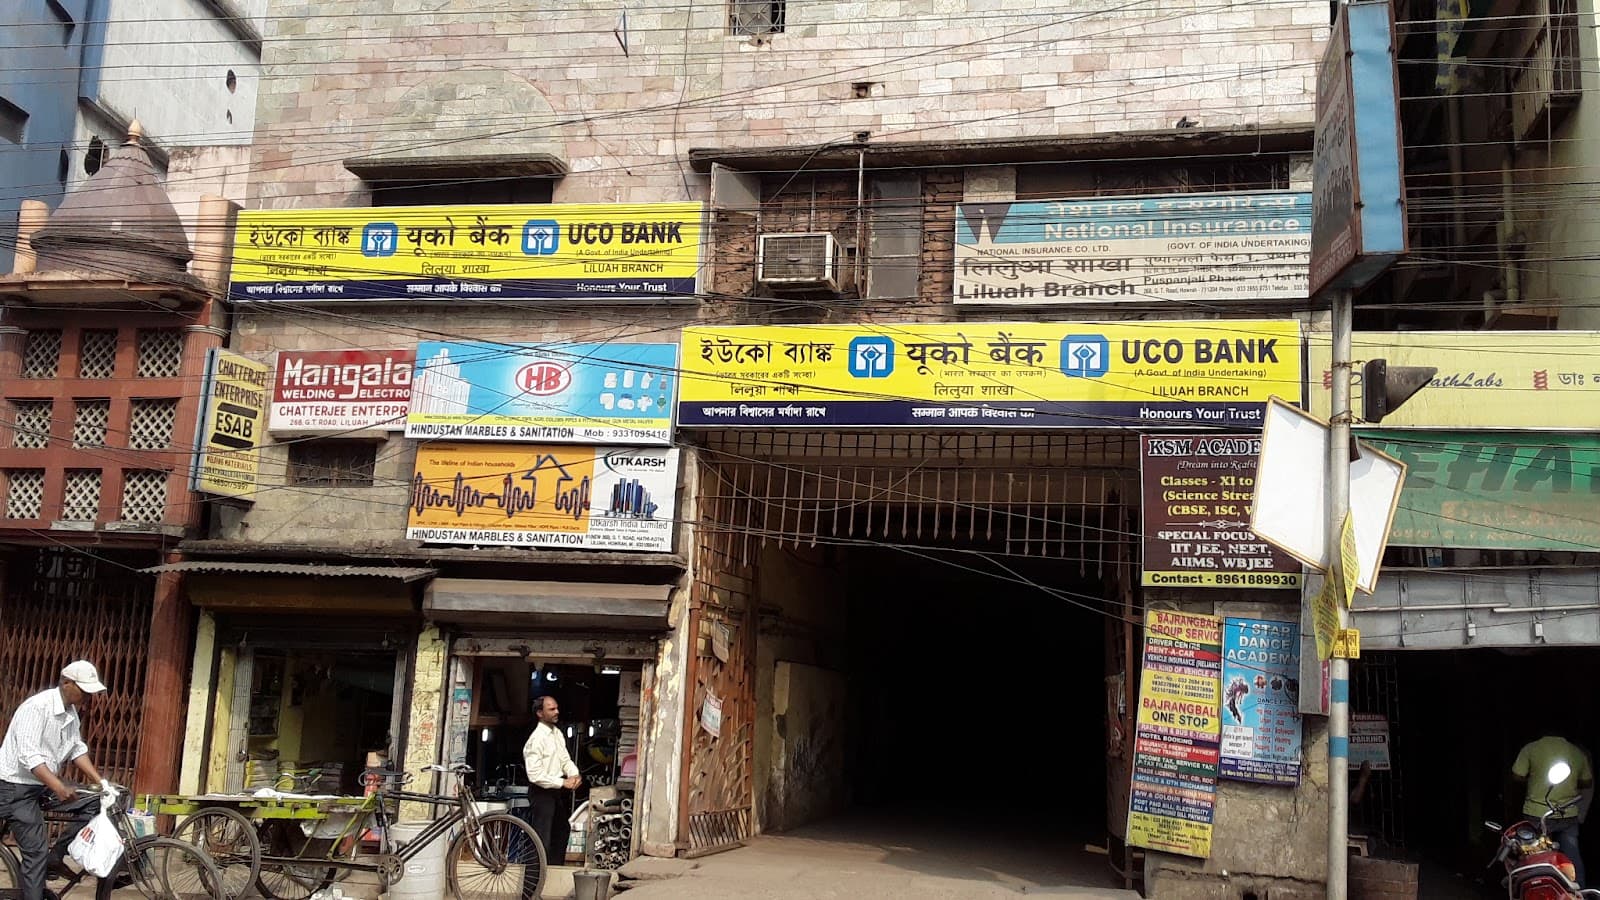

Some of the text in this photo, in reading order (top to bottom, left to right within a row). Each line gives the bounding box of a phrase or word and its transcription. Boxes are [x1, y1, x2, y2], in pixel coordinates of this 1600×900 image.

[250, 222, 352, 248] ইউকো ব্যাঙ্ক
[568, 222, 683, 245] UCO BANK
[1044, 218, 1300, 240] National Insurance
[406, 216, 513, 257] यूको बैंक
[1241, 238, 1311, 248] UNDERTAKING)
[612, 248, 628, 256] India
[977, 248, 1020, 256] NATIONAL
[1022, 246, 1072, 255] INSURANCE
[462, 264, 490, 274] शाखा
[584, 264, 664, 273] LILUAH BRANCH
[1064, 257, 1133, 273] शाखा
[576, 282, 667, 292] Honours Your Trust
[958, 282, 1034, 300] Liluah
[1044, 280, 1135, 298] Branch
[700, 336, 836, 365] ইউকো ব্যাঙ্ক
[904, 332, 1048, 376] यूको बैंक
[1122, 338, 1279, 364] UCO BANK
[218, 358, 266, 386] CHATTERJEE
[1208, 369, 1266, 378] Undertaking)
[524, 366, 562, 392] HB
[1430, 371, 1503, 388] athLabs
[214, 381, 264, 408] ENTERPRISE
[282, 389, 410, 398] WELDING ELECTRO
[731, 382, 766, 397] লিলুয়া
[934, 382, 1014, 398] लिलुया शाखा
[1152, 386, 1249, 396] LILUAH BRANCH
[280, 406, 408, 416] CHATTERJEE ENTERPR
[702, 406, 736, 417] আপনার
[740, 404, 775, 418] বিশ্বাসের
[806, 406, 826, 417] রাখে
[912, 408, 946, 418] सम्मान
[1140, 408, 1261, 419] Honours Your Trust
[215, 412, 253, 438] ESAB
[410, 424, 667, 438] HINDUSTAN MARBLES & SANITATION Mob 9331095416
[1148, 438, 1262, 456] KSM ACADE
[611, 457, 666, 467] UTKARSH
[1177, 460, 1208, 470] (Dream
[1211, 460, 1228, 469] into
[1160, 476, 1254, 486] Classes XI to
[1162, 490, 1218, 502] (Science
[1168, 505, 1212, 517] (CBSE,
[1214, 506, 1241, 517] ISC,
[591, 518, 618, 527] Utkarsh
[620, 519, 638, 528] India
[640, 520, 668, 530] Limited
[412, 530, 467, 540] HINDUSTAN
[469, 531, 514, 542] MARBLES
[517, 532, 523, 542] &
[526, 532, 584, 545] SANITATION
[1158, 532, 1256, 540] SPECIAL FOCUS
[1170, 544, 1272, 556] IIT JEE, NEET,
[1170, 558, 1274, 570] AIIMS, WBJEE
[1152, 574, 1297, 586] Contact 8961889930
[1150, 624, 1182, 637] GROUP
[1238, 622, 1291, 636] 7 STAR
[1148, 638, 1173, 646] DRIVER
[1240, 636, 1290, 650] DANCE
[1148, 646, 1194, 658] RENT-A-CAR
[1226, 649, 1300, 664] ACADEMY
[1168, 656, 1196, 666] INSURANCE
[1183, 667, 1208, 676] VEHICLE
[1152, 711, 1208, 728] ONE STOP
[1140, 732, 1192, 745] HOTEL BOOKING
[1192, 746, 1216, 756] PAYMENT
[1138, 754, 1160, 762] INCOME
[1176, 760, 1200, 769] SERVICE
[1137, 774, 1159, 784] MOBILE
[1154, 793, 1212, 808] COLOUR PRINTING
[1188, 814, 1210, 822] PAYMENT
